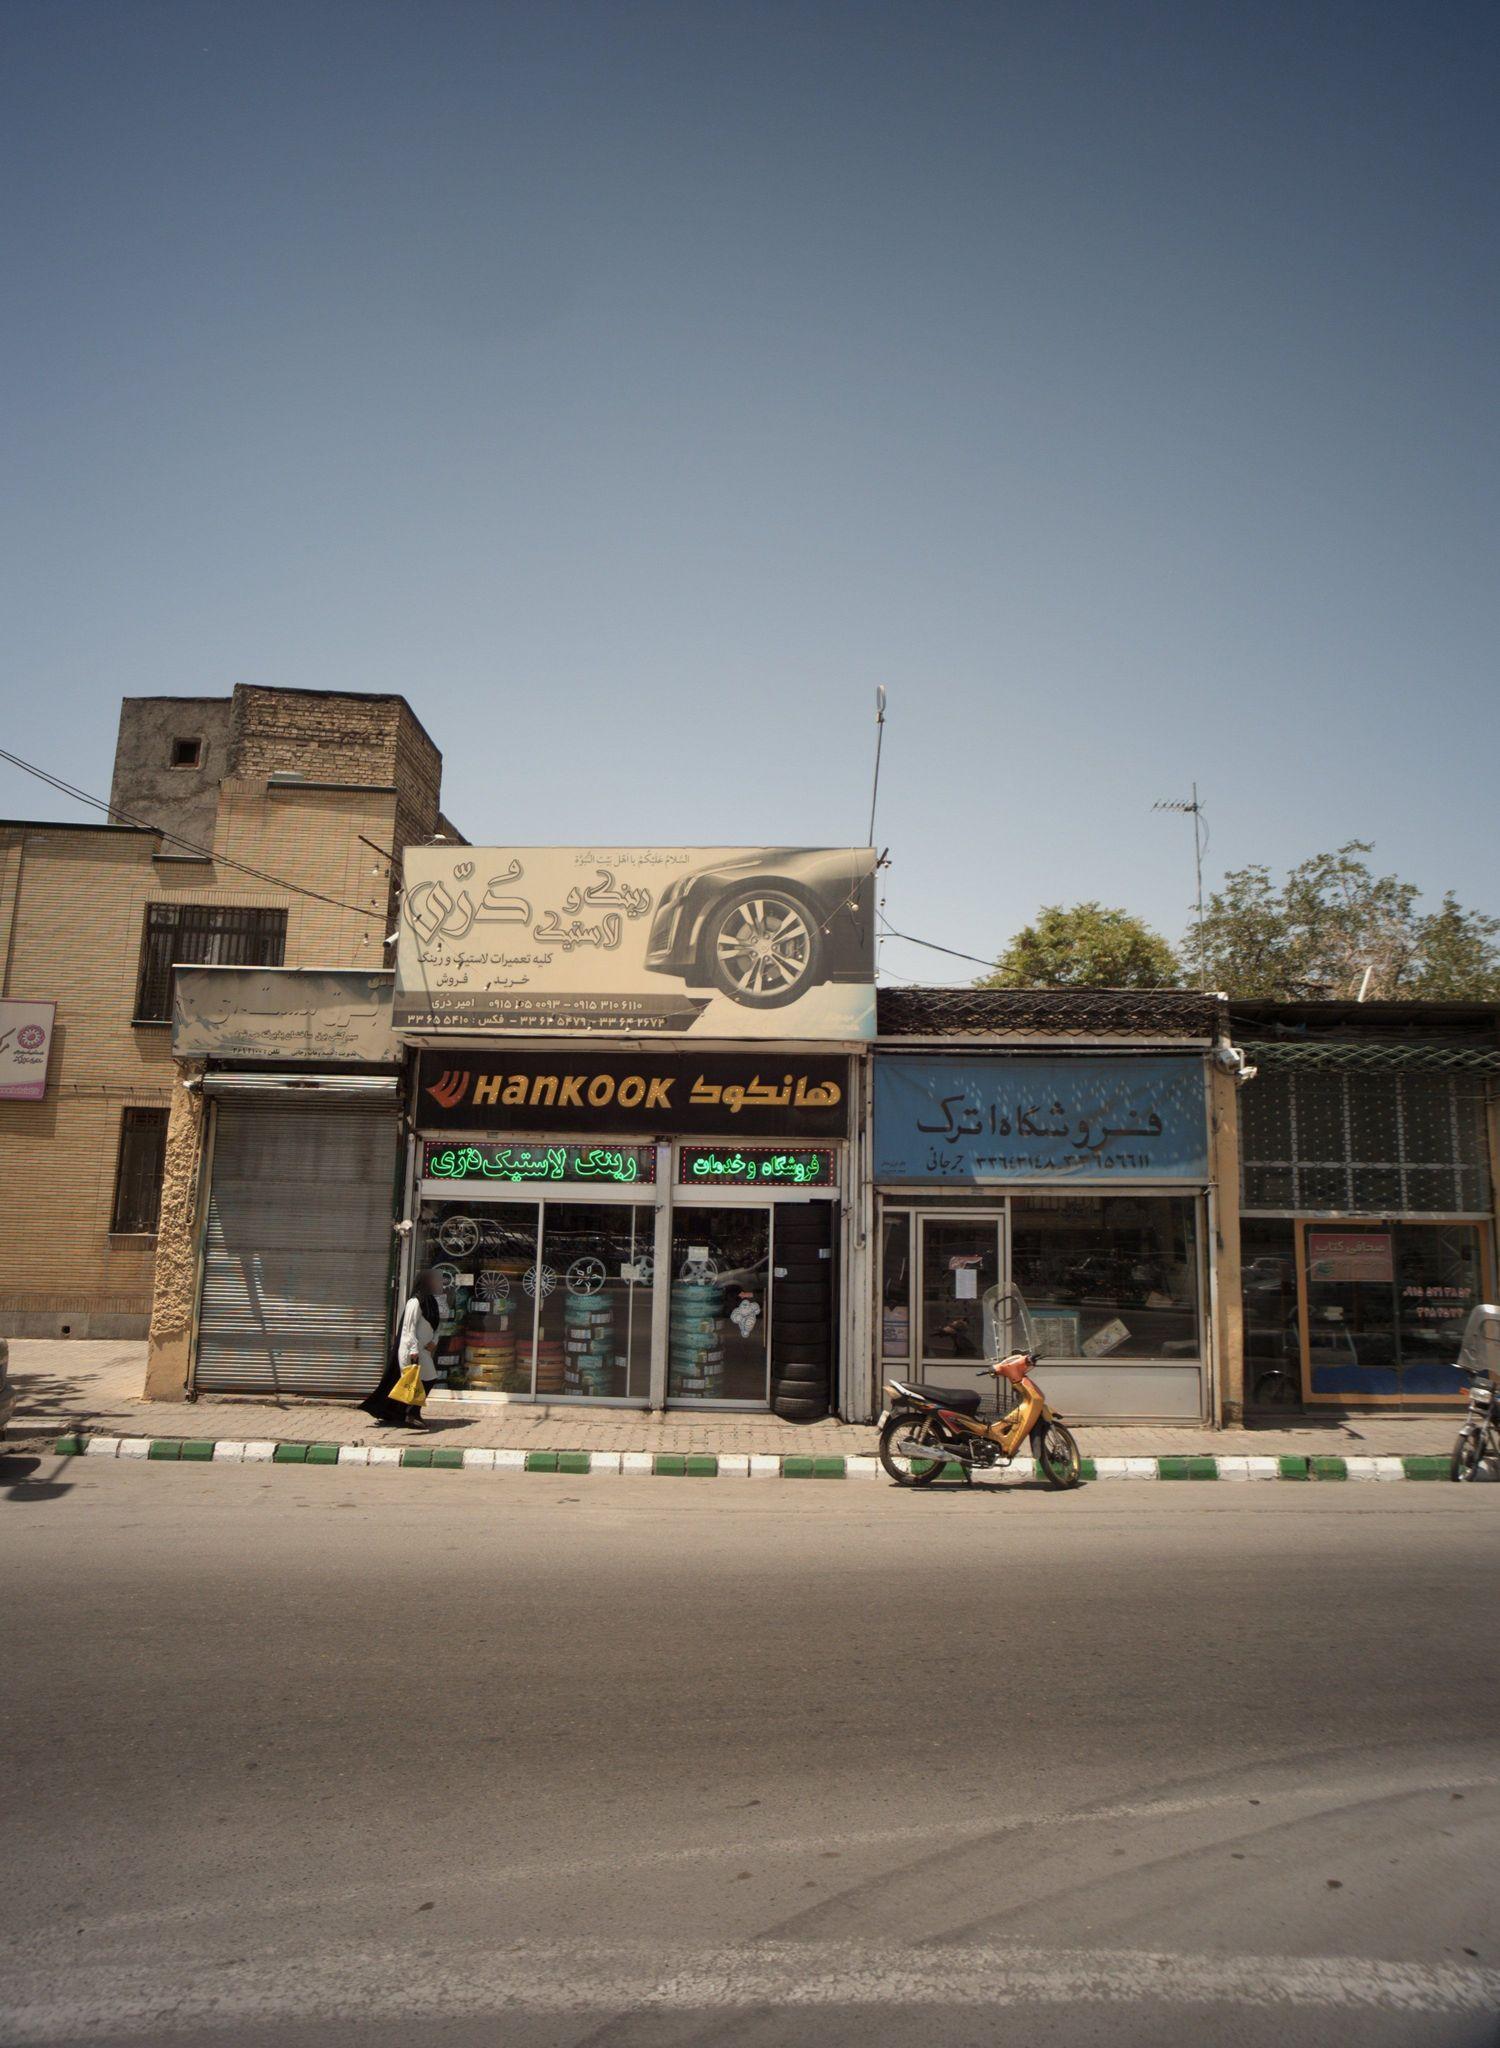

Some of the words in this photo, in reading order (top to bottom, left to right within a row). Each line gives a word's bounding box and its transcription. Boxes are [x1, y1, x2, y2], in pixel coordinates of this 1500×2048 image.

[562, 886, 583, 914] و
[534, 910, 621, 949] لاستیک
[417, 952, 442, 966] رینگ
[453, 952, 489, 968] لاستیک
[490, 953, 531, 967] تعمیرات
[533, 952, 553, 967] کلیه
[436, 972, 469, 987] فروش
[494, 975, 530, 988] خرید
[455, 999, 475, 1009] امیر
[489, 1000, 512, 1009] ۰۹۱۵
[573, 1000, 597, 1010] ۰۹۱۵
[477, 1015, 505, 1027] فکس
[689, 1073, 842, 1113] هانکوک
[999, 1102, 1164, 1149] فروشگاه
[482, 1148, 567, 1182] لاستیک
[575, 1149, 637, 1182] رینگ
[693, 1153, 746, 1175] خدمات
[746, 1161, 757, 1180] و
[761, 1154, 820, 1182] فروشگاه
